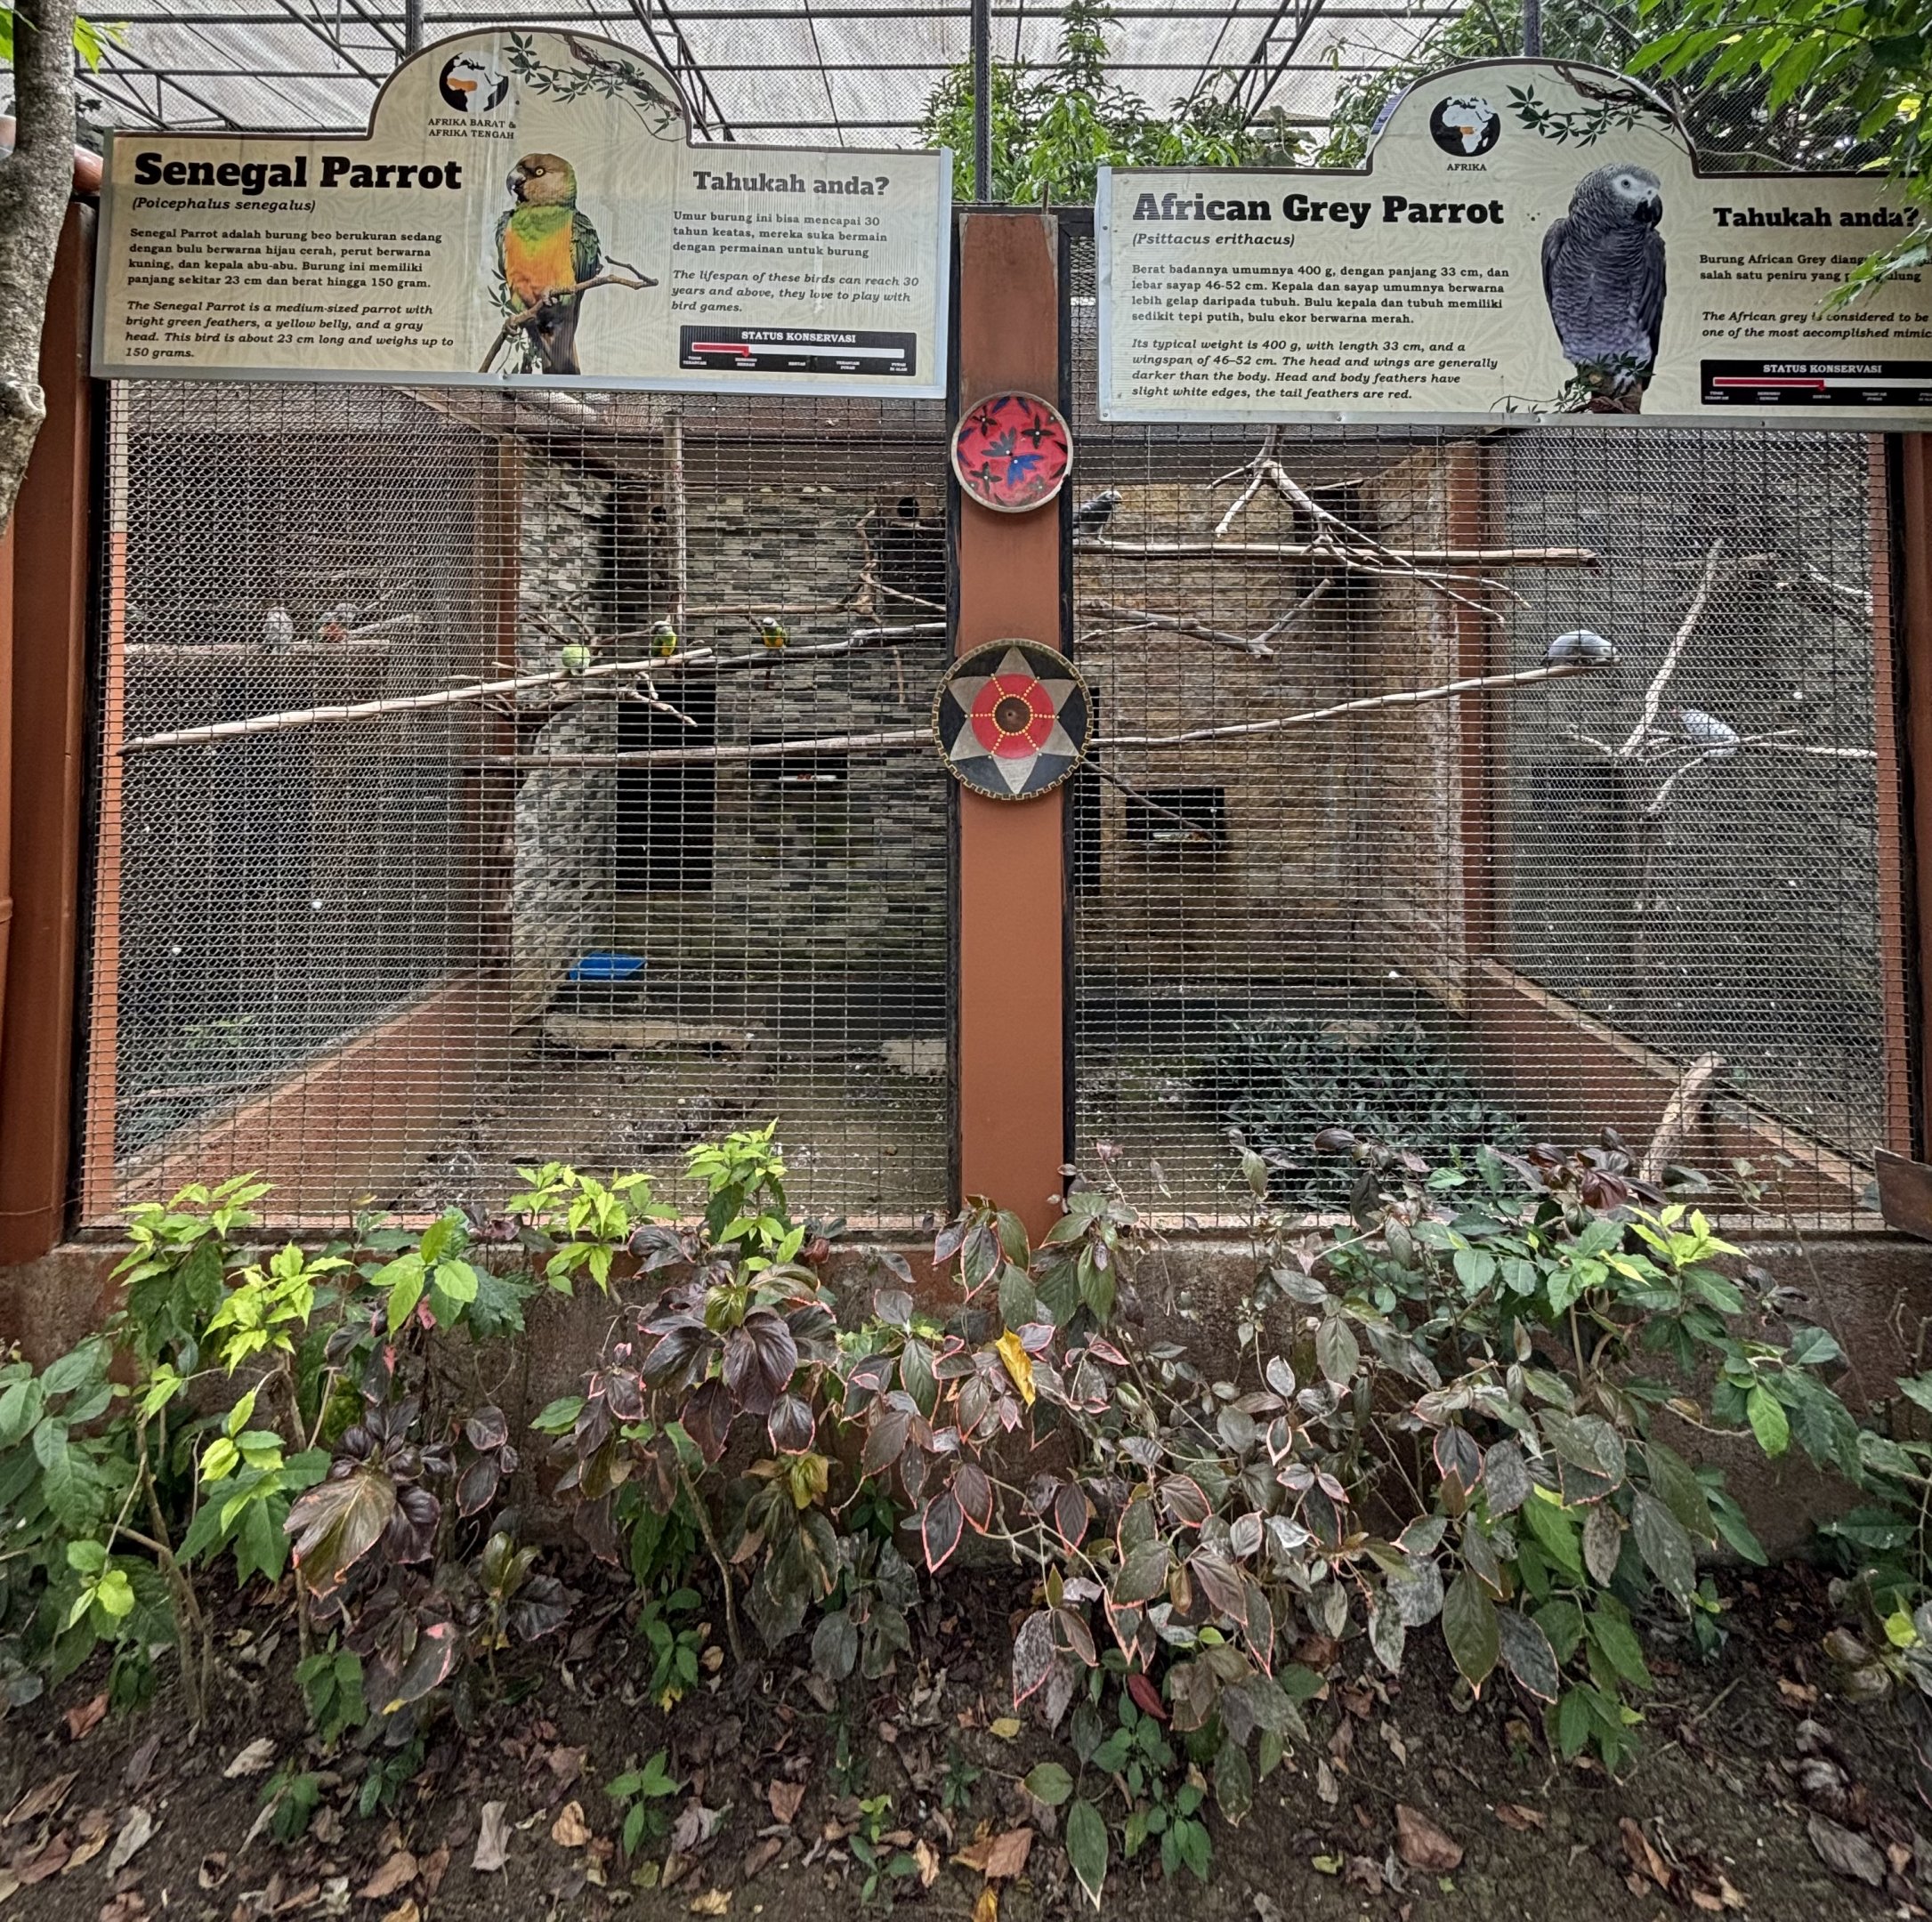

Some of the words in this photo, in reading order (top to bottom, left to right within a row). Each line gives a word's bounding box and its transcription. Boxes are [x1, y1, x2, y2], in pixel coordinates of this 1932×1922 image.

[427, 117, 466, 125] AFRIKA
[469, 118, 505, 127] BARAT
[470, 129, 513, 139] TENGAH
[134, 153, 307, 195] Senegal
[319, 156, 462, 189] Parrot
[1446, 163, 1486, 171] AFRIKA
[692, 171, 805, 192] Tahukah
[813, 176, 889, 195] anda?
[132, 197, 230, 211] (Poicephalus
[234, 199, 315, 213] senegalus)
[1133, 193, 1271, 220] African
[1282, 194, 1370, 229] Grey
[1382, 196, 1504, 223] Parrot
[673, 210, 707, 220] Umur
[710, 212, 752, 224] burung
[756, 213, 772, 222] ini
[776, 214, 799, 222] bisa
[804, 217, 861, 227] mencapai
[864, 216, 879, 226] 30
[1712, 207, 1831, 226] Tahukah
[1839, 206, 1919, 227] anda?
[130, 228, 176, 239] Senegal
[180, 229, 217, 238] Parrot
[222, 230, 261, 238] adalah
[265, 230, 307, 241] burung
[311, 230, 331, 239] beo
[335, 230, 397, 240] berukuran
[400, 232, 441, 244] sedang
[673, 226, 707, 235] tahun
[712, 227, 754, 238] keatas,
[758, 230, 803, 238] mereka
[806, 230, 834, 239] suka
[838, 231, 886, 241] bermain
[1132, 233, 1209, 246] (Psittacus
[1215, 233, 1294, 247] erithacus)
[129, 243, 172, 254] dengan
[176, 244, 202, 253] bulu
[206, 244, 261, 254] berwarna
[265, 246, 295, 256] hijau
[299, 246, 335, 256] cerah,
[340, 247, 372, 257] perut
[376, 246, 431, 256] berwarna
[672, 241, 715, 253] dengan
[720, 244, 783, 254] permainan
[787, 246, 823, 254] untuk
[827, 246, 869, 258] burung
[128, 258, 174, 271] kuning,
[178, 259, 199, 269] dan
[205, 260, 243, 271] kepala
[247, 261, 297, 270] abu-abu.
[302, 262, 345, 272] Burung
[349, 262, 365, 271] ini
[368, 262, 422, 271] memiliki
[1700, 254, 1744, 265] Burung
[1748, 254, 1793, 263] African
[1797, 254, 1826, 266] Grey
[673, 270, 695, 279] The
[699, 271, 748, 282] lifespan
[752, 272, 766, 283] of
[768, 272, 800, 282] these
[804, 273, 835, 283] birds
[865, 277, 899, 285] reach
[903, 277, 918, 286] 30
[1700, 270, 1732, 279] salah
[1736, 271, 1762, 279] satu
[1766, 271, 1807, 282] peniru
[1810, 272, 1840, 282] yang
[1132, 280, 1162, 288] lebar
[1167, 282, 1200, 292] sayap
[1205, 280, 1241, 289] 46-52
[1272, 281, 1314, 293] Kepala
[1317, 281, 1340, 290] dan
[1344, 284, 1378, 294] sayap
[1383, 285, 1443, 294] umumnya
[1448, 283, 1504, 292] berwarna
[671, 287, 705, 296] years
[708, 287, 732, 295] and
[736, 287, 773, 298] above,
[779, 288, 805, 300] they
[810, 289, 833, 299] love
[837, 291, 849, 299] to
[851, 291, 879, 303] play
[884, 292, 909, 302] with
[1132, 295, 1161, 304] lebih
[1166, 296, 1198, 307] gelap
[1202, 296, 1256, 308] daripada
[1259, 297, 1299, 306] tubuh.
[1304, 297, 1332, 306] Bulu
[1337, 297, 1377, 309] kepala
[1380, 298, 1403, 307] dan
[1407, 298, 1443, 307] tubuh
[1448, 299, 1502, 308] memiliki
[126, 300, 150, 310] The
[153, 301, 202, 312] Senegal
[205, 302, 245, 311] Parrot
[249, 303, 259, 311] is
[275, 303, 359, 312] medium-sized
[360, 305, 401, 315] parrot
[406, 304, 432, 314] with
[671, 301, 697, 310] bird
[699, 303, 741, 312] games.
[1132, 311, 1174, 320] sedikit
[1178, 311, 1202, 323] tepi
[1207, 312, 1243, 323] putih,
[1248, 312, 1274, 321] bulu
[1279, 312, 1306, 322] ekor
[1310, 313, 1367, 322] berwarna
[1371, 314, 1413, 323] merah.
[1702, 311, 1725, 320] The
[1727, 311, 1776, 322] African
[1779, 314, 1807, 323] grey
[1826, 312, 1894, 322] considered
[1899, 313, 1911, 321] to
[1914, 312, 1928, 322] be
[741, 331, 783, 340] STATUS
[786, 332, 855, 343] KONSERVASI
[1727, 327, 1742, 339] of
[1744, 327, 1764, 336] the
[1768, 328, 1799, 336] most
[125, 347, 149, 356] 150
[151, 350, 194, 359] grams.
[1763, 364, 1807, 372] STATUS
[1809, 365, 1881, 373] KONSERVASI
[1132, 370, 1176, 379] darker
[1179, 370, 1209, 380] than
[1213, 371, 1233, 380] the
[1237, 371, 1270, 383] body.
[1274, 372, 1307, 381] Head
[1312, 372, 1337, 381] and
[1340, 372, 1370, 384] body
[1371, 373, 1426, 384] feathers
[1430, 374, 1459, 383] have
[1132, 386, 1168, 397] slight
[1173, 387, 1208, 396] white
[1211, 387, 1249, 399] edges,
[1256, 388, 1275, 397] the
[1280, 388, 1302, 397] tail
[1304, 388, 1359, 400] feathers
[1387, 389, 1411, 399] red.
